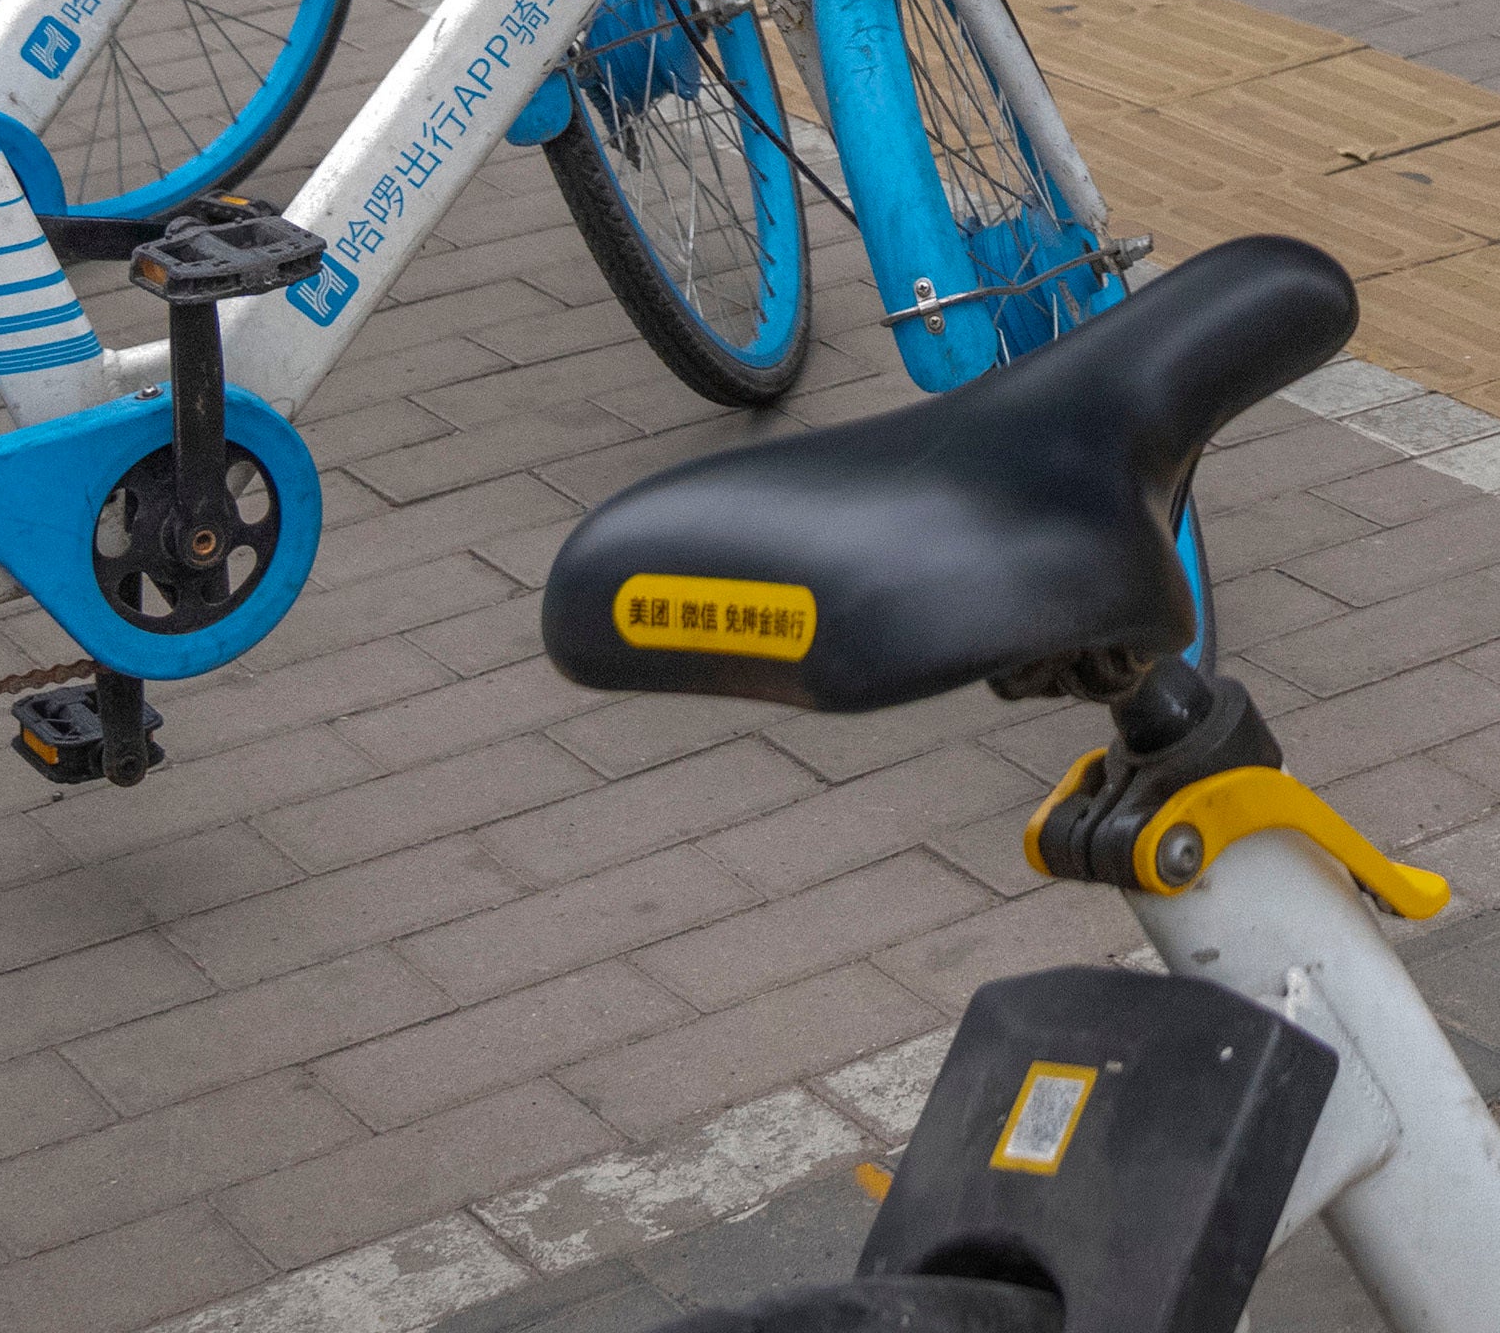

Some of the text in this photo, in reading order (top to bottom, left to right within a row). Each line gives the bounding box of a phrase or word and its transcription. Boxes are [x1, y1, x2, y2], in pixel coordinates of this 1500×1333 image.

[628, 595, 806, 639] 美团 微信 免押金骑行
